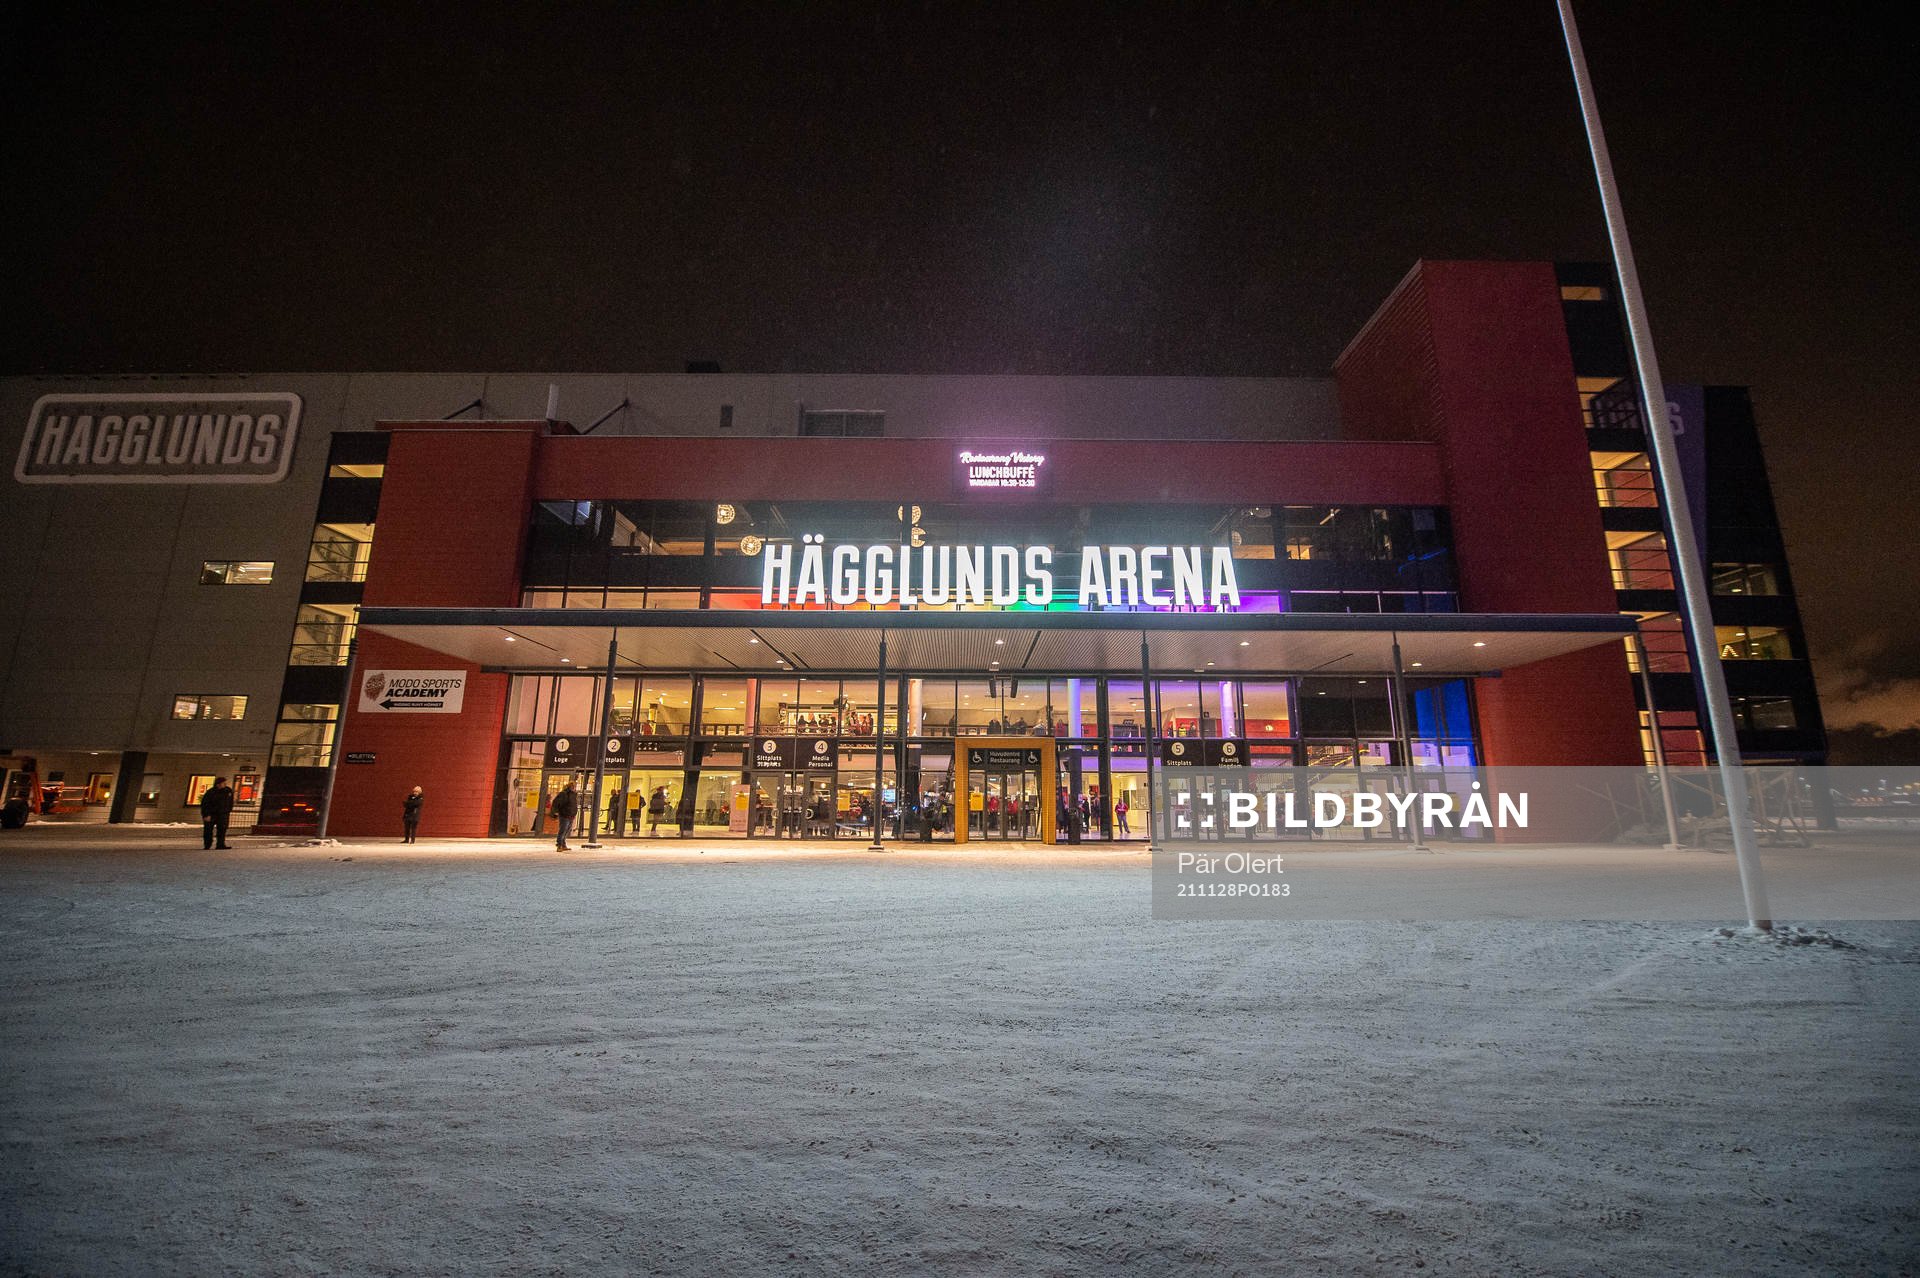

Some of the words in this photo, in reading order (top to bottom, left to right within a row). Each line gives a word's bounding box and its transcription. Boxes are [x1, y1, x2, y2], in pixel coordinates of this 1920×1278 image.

[969, 464, 1035, 478] LUNCHBUFFÉ
[761, 534, 1053, 606] HÄGGLUNDS
[1078, 545, 1241, 606] ARENA
[389, 679, 421, 688] MODO
[421, 679, 462, 688] SPORTS
[385, 689, 448, 697] ACADEMY
